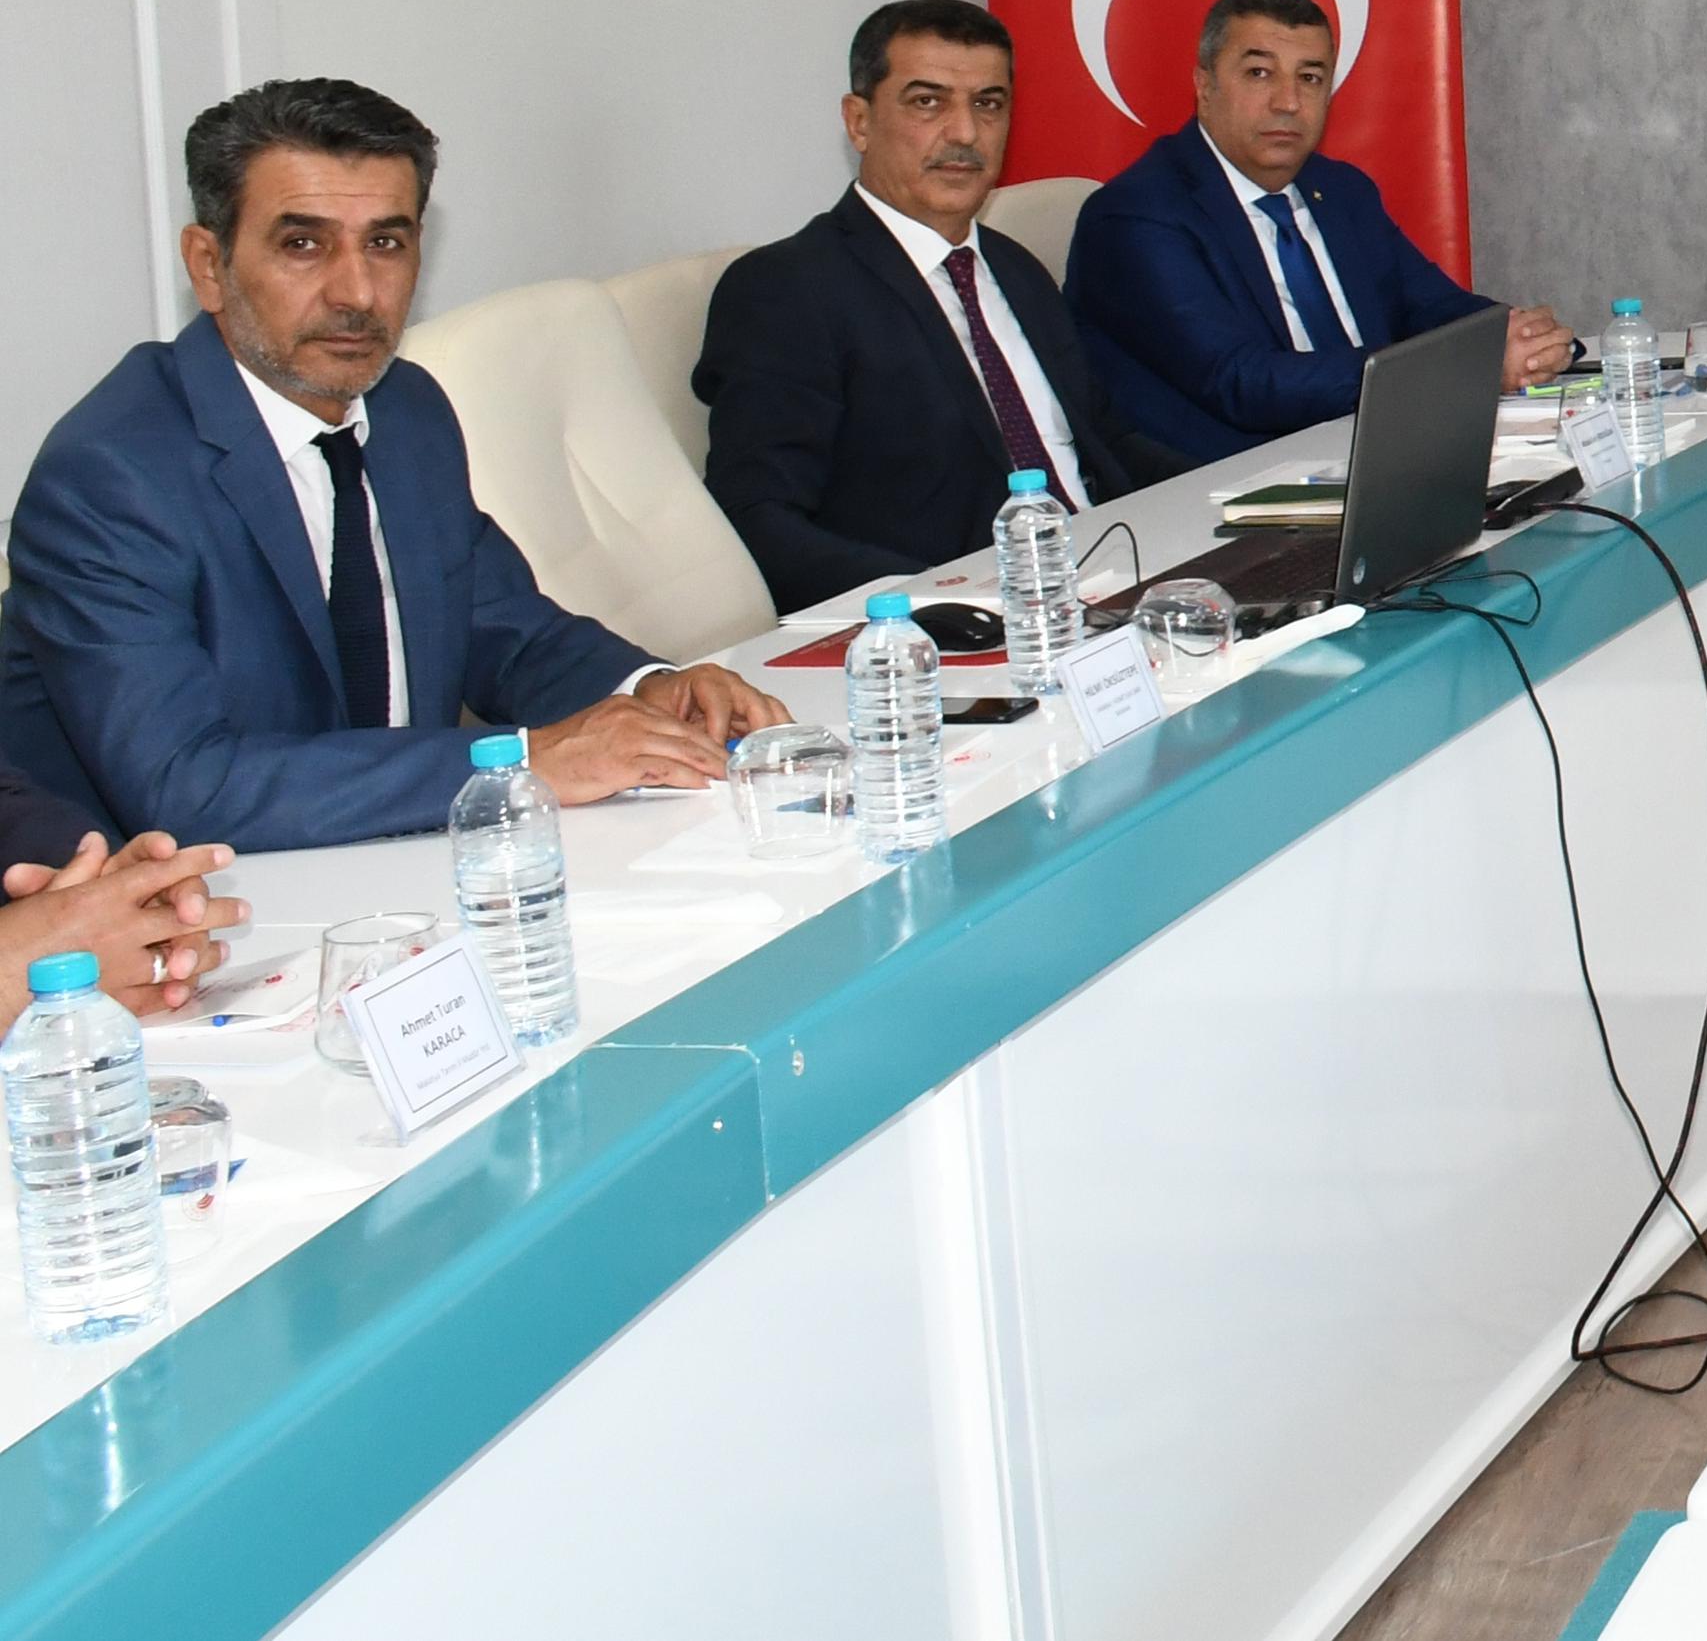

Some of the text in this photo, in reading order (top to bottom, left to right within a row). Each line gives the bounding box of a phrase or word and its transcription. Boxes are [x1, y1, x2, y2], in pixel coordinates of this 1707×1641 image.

[400, 994, 466, 1038] Ahmet Turan
[422, 1024, 467, 1058] KARACA
